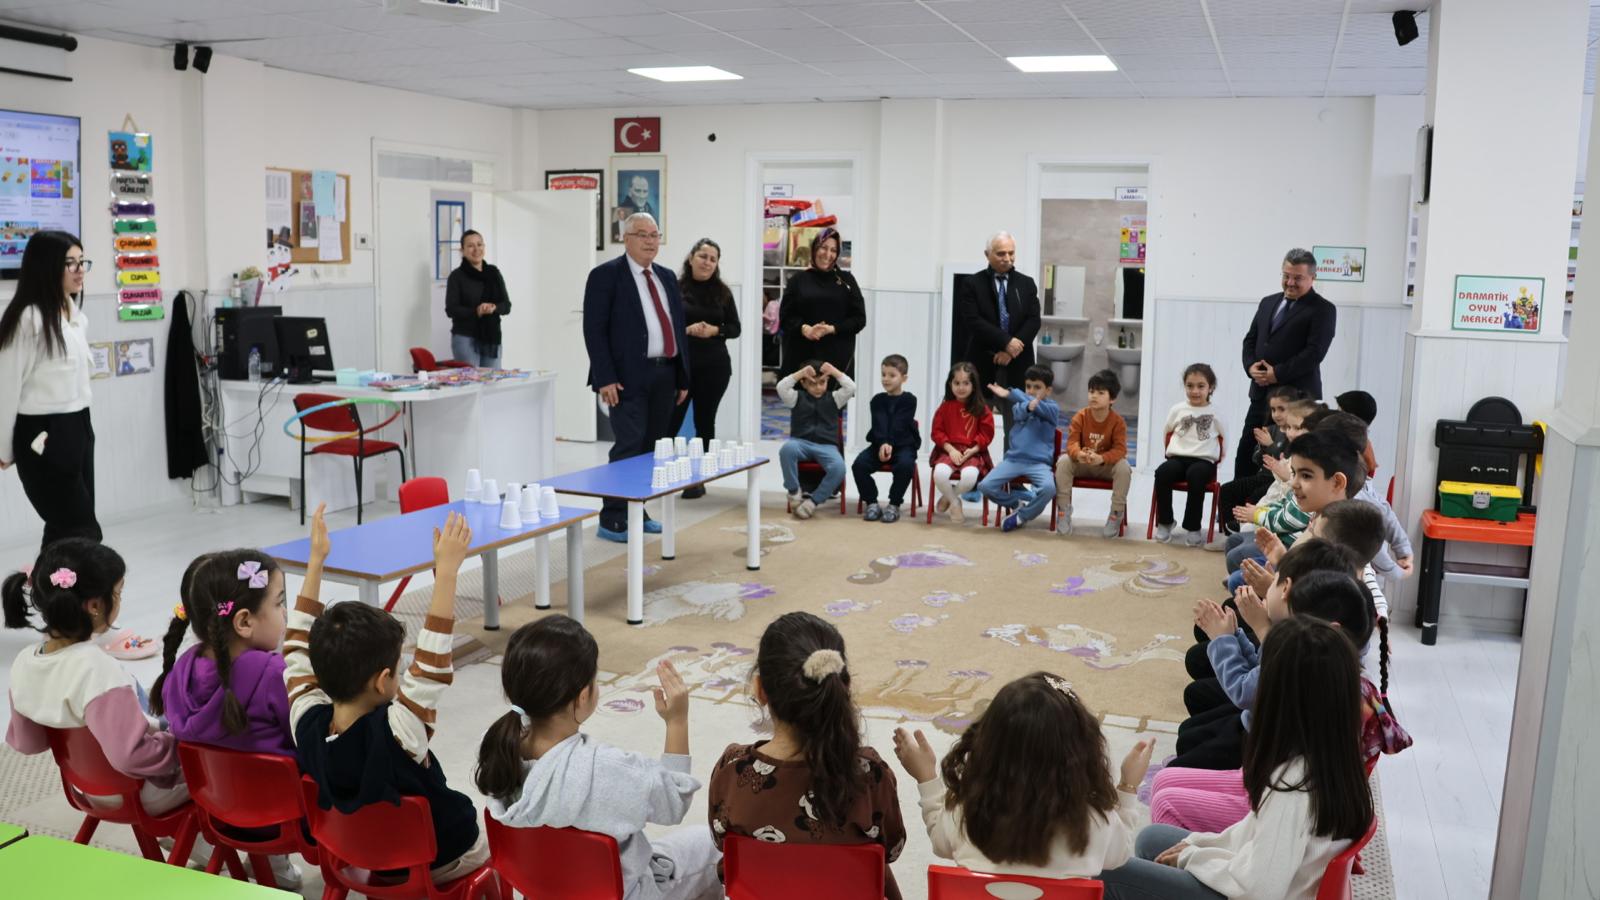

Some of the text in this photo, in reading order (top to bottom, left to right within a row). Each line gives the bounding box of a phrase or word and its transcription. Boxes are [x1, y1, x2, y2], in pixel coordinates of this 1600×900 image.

[1458, 292, 1509, 302] DRAMATİK
[131, 309, 152, 317] PAZAR
[1468, 304, 1497, 313] OYUN
[1460, 314, 1503, 324] MERKEZİ
